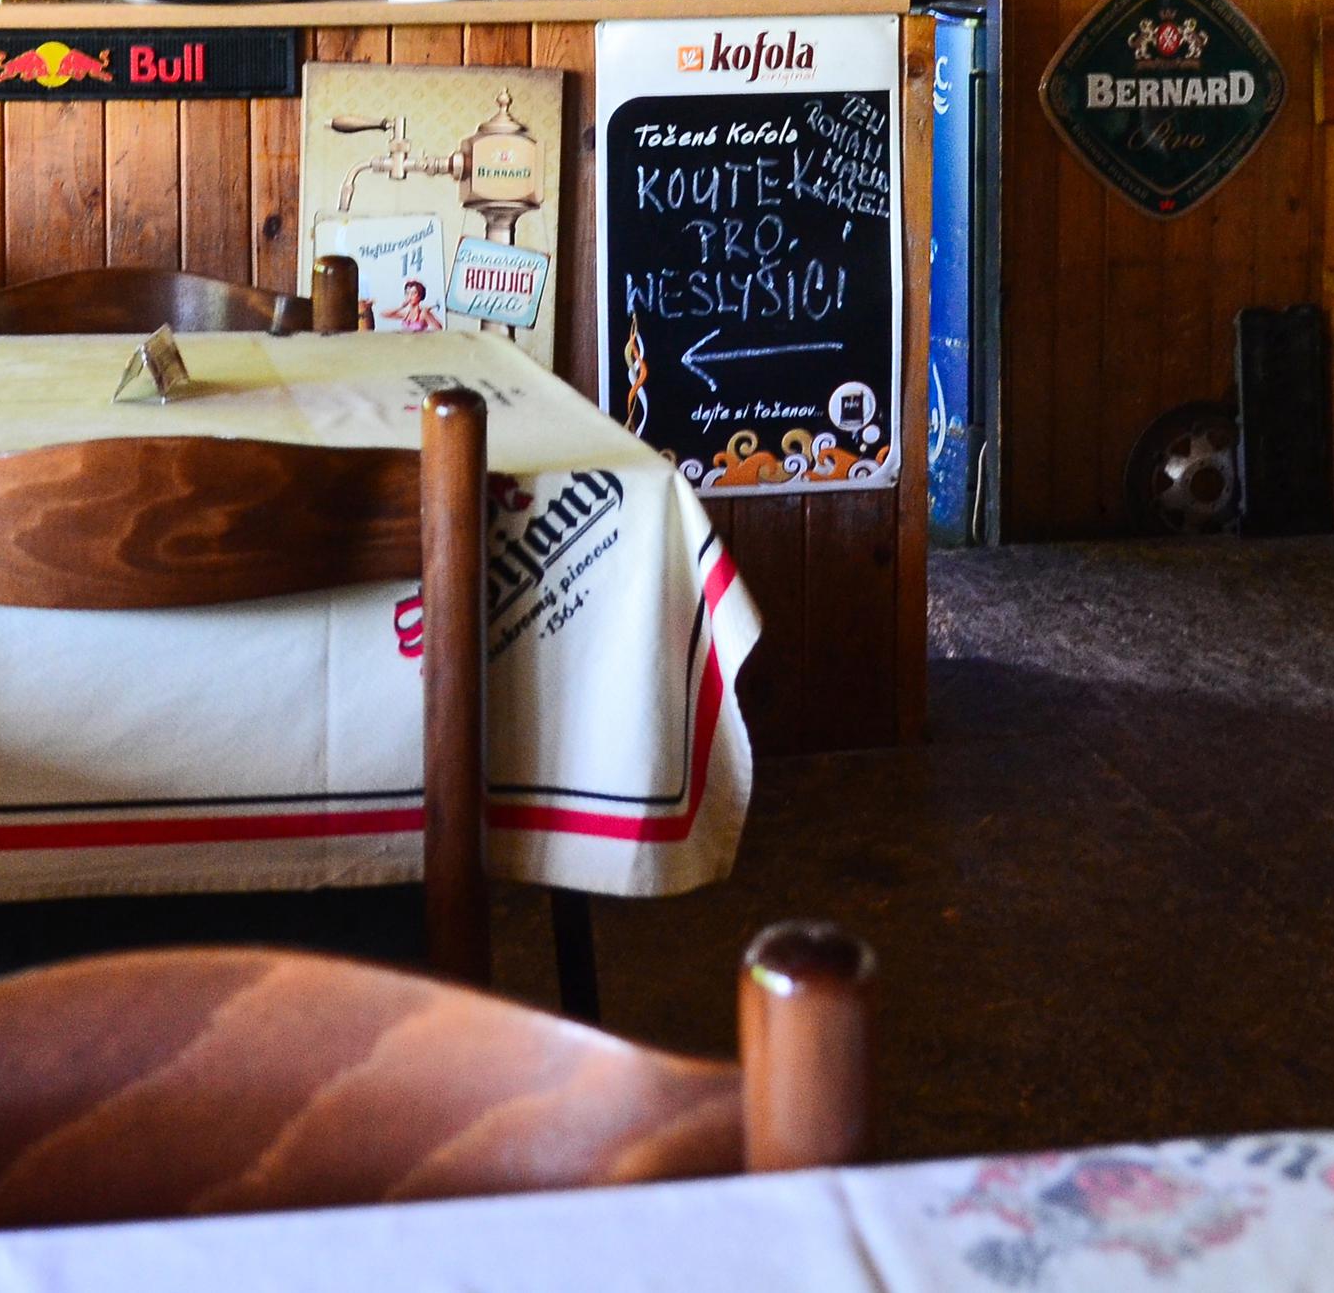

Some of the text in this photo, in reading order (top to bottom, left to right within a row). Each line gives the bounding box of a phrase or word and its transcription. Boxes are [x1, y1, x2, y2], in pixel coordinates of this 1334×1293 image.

[129, 43, 206, 86] Bull
[709, 29, 816, 84] kofola
[1086, 69, 1256, 109] BERNARD
[726, 115, 799, 146] Kofola
[476, 165, 533, 179] BERNARD
[681, 213, 785, 265] PRO
[400, 246, 425, 279] 14
[690, 402, 731, 435] dejte
